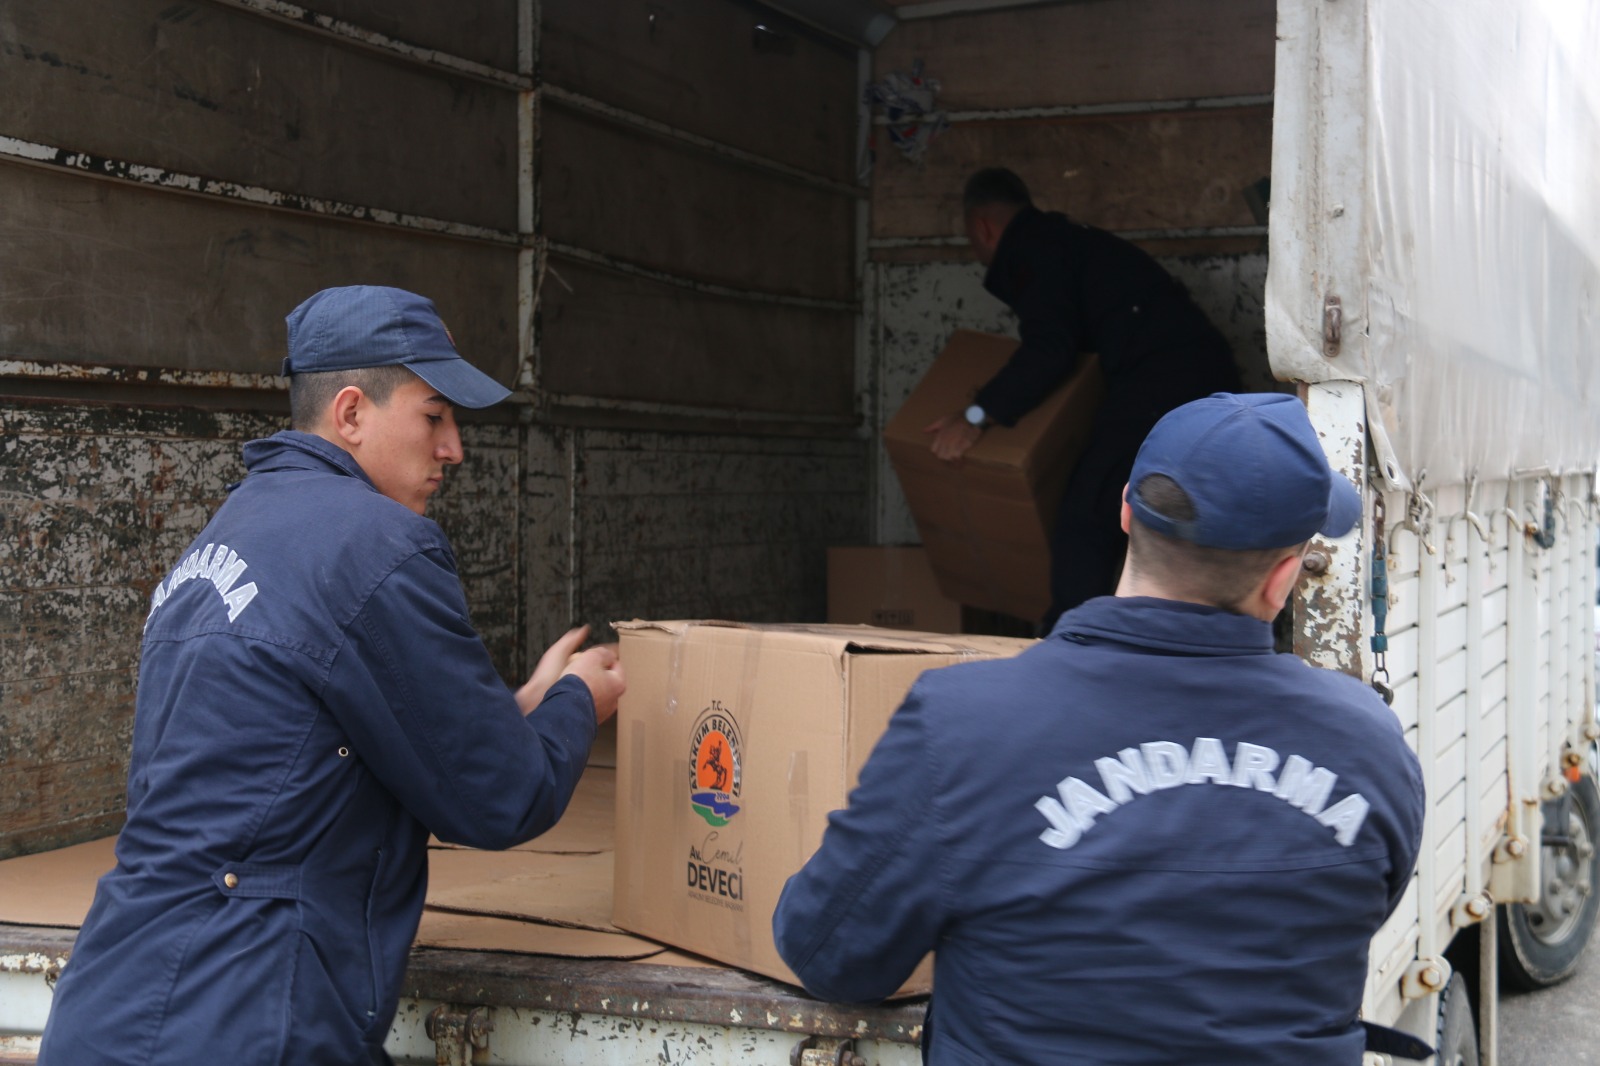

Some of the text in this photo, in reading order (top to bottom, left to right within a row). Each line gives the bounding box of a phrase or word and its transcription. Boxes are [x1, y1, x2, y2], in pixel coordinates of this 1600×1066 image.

[143, 543, 259, 635] ANDARMA
[712, 700, 723, 711] T.C.
[691, 723, 710, 790] ATAKUM
[1034, 737, 1370, 849] JANDARMA
[688, 861, 743, 901] DEVECİ
